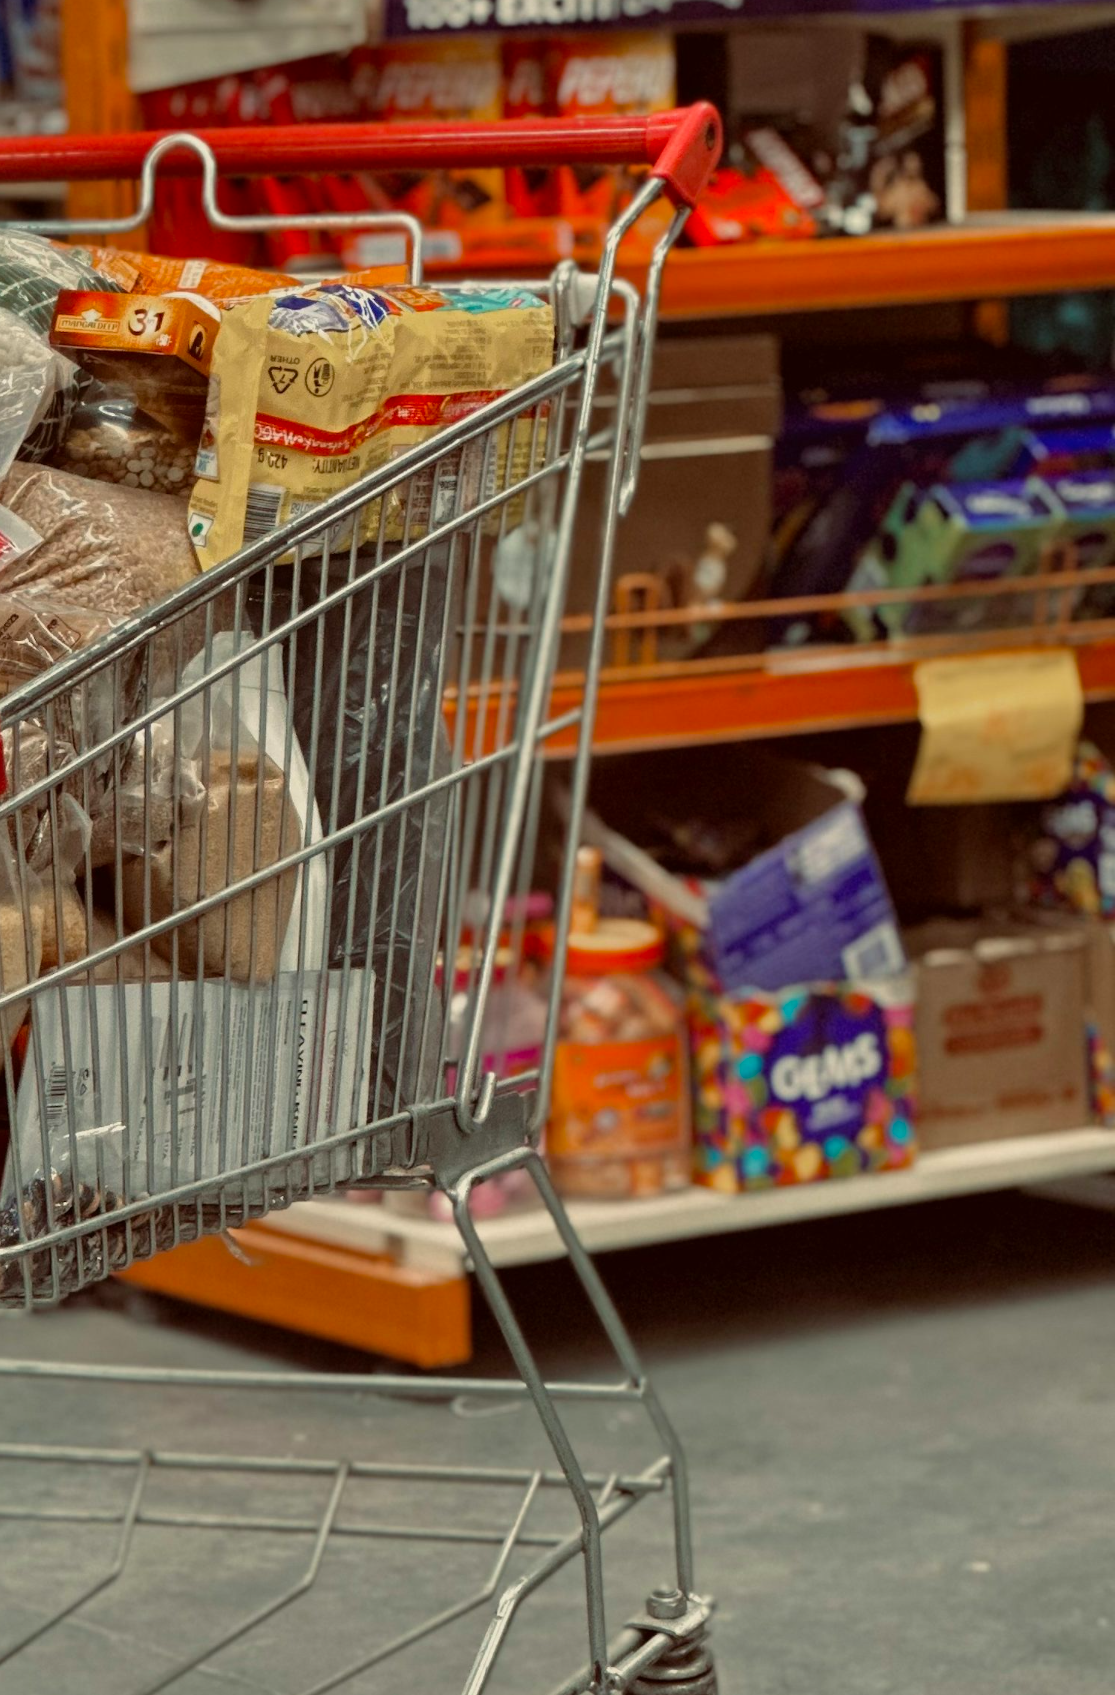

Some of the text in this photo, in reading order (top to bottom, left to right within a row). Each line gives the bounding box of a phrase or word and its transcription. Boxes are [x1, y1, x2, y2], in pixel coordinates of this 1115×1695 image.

[128, 308, 148, 336] 3
[153, 311, 165, 333] 1
[270, 354, 301, 365] OTHER
[278, 373, 286, 384] 7
[770, 1032, 882, 1102] GEMS
